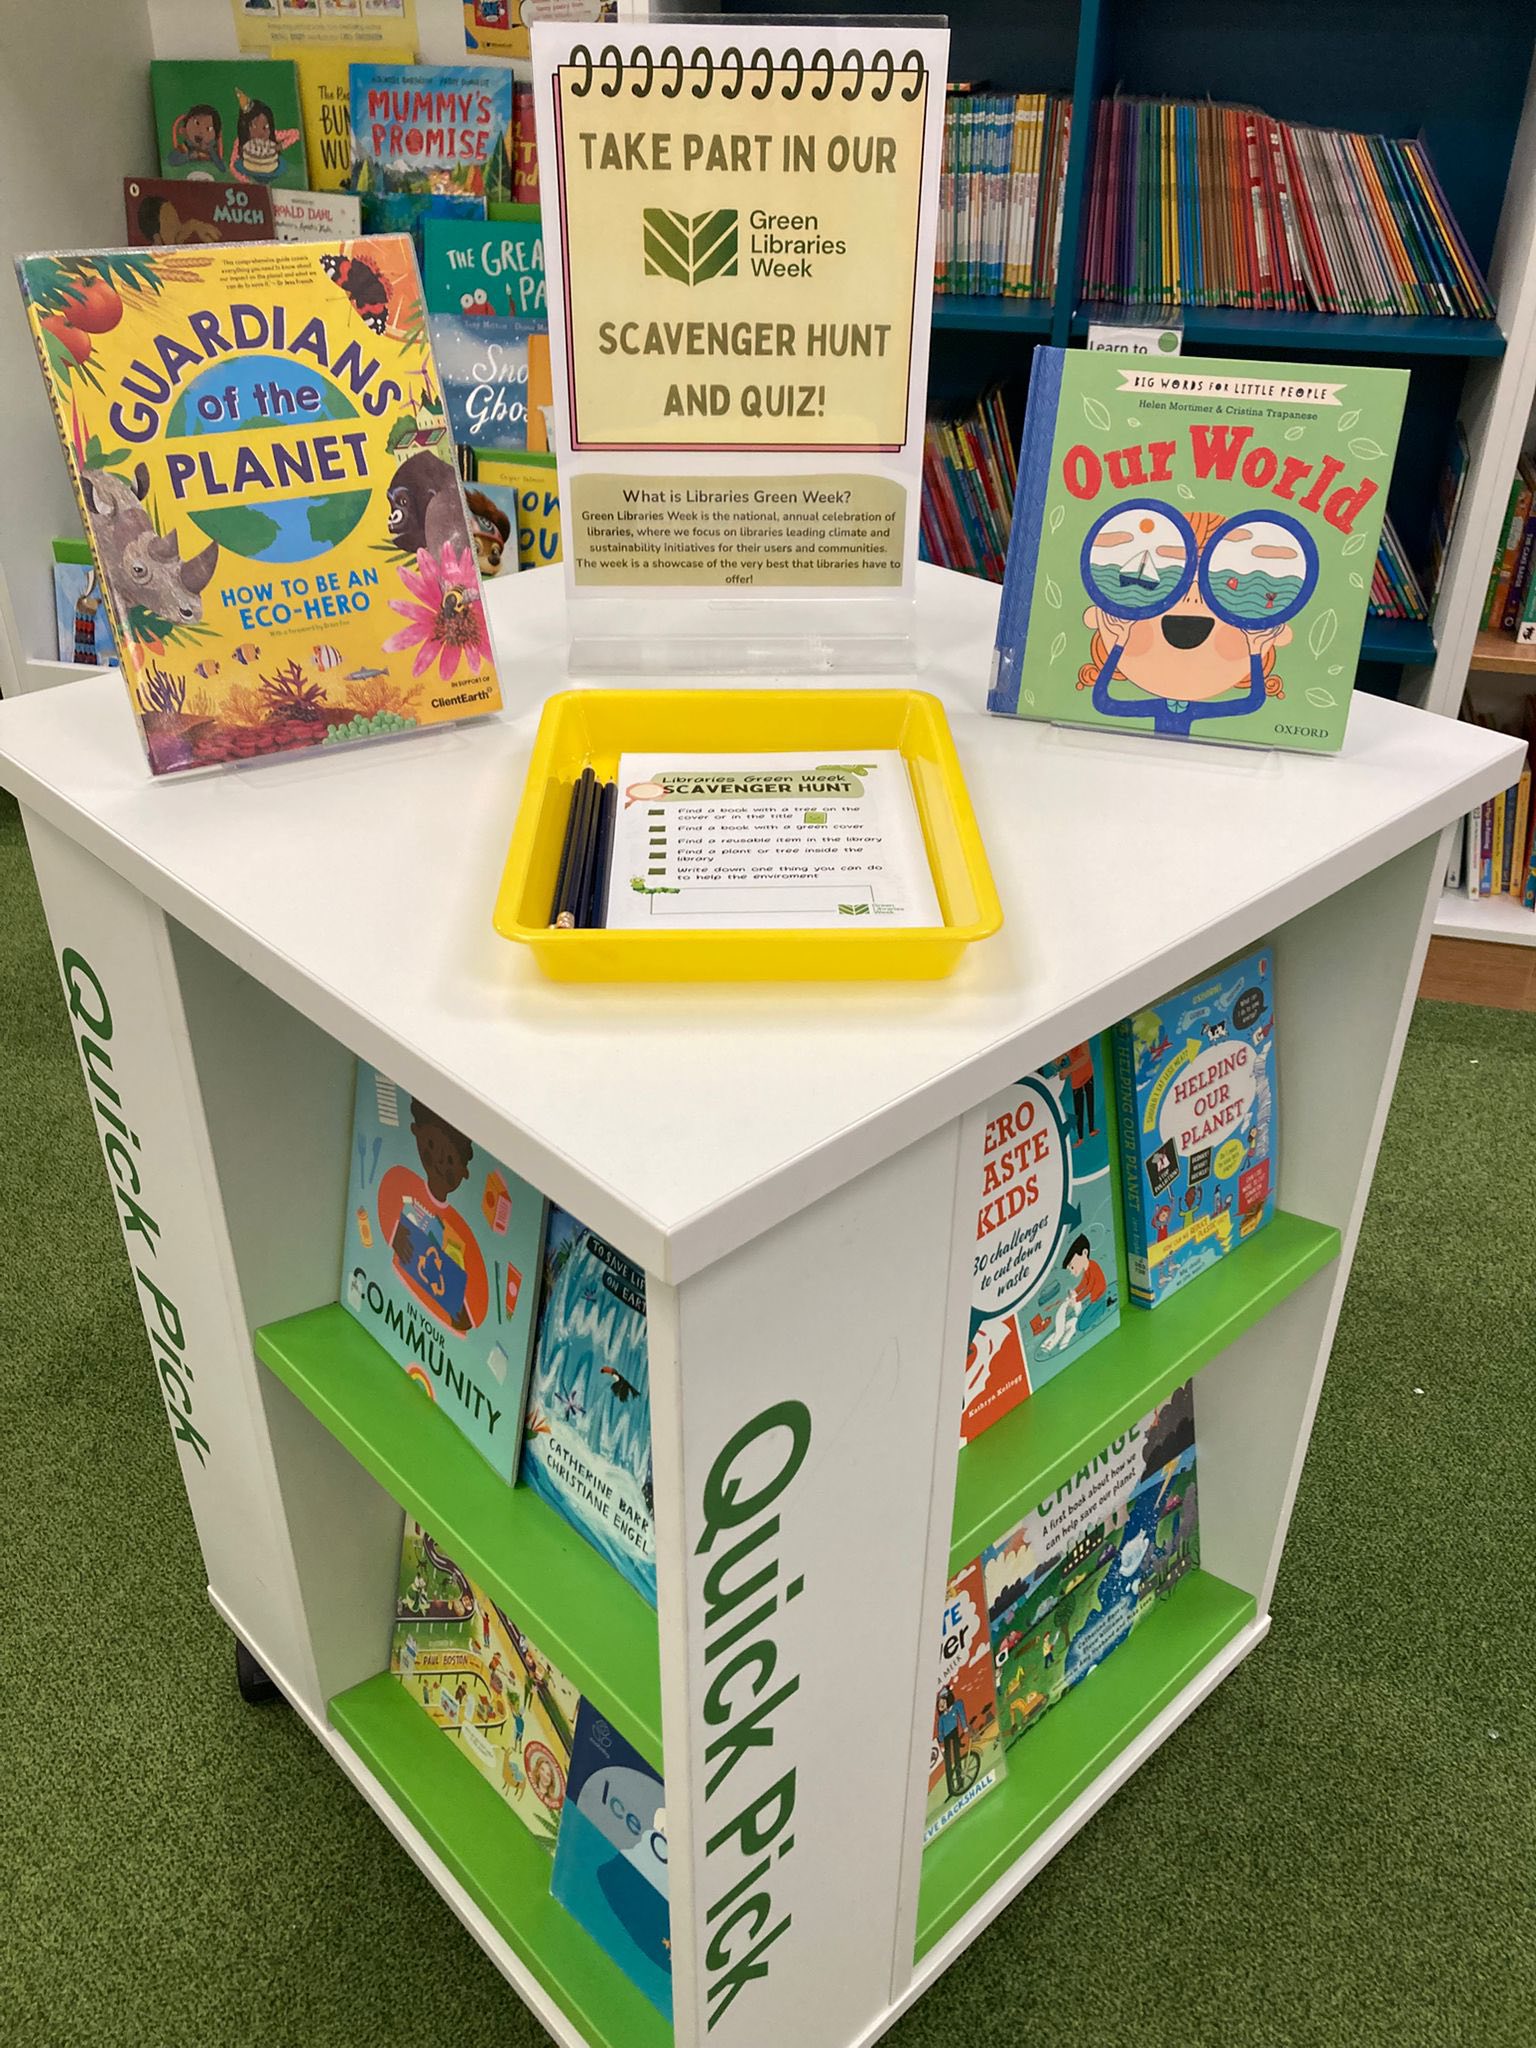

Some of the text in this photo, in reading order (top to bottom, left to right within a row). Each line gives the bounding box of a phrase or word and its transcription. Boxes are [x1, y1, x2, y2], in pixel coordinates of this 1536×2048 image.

[368, 89, 492, 124] MUMMY'S
[371, 123, 490, 160] PROMISE
[579, 132, 897, 173] TAKE PART IN OUR
[213, 205, 265, 224] MUCH
[225, 188, 248, 207] SO
[272, 204, 333, 221] ROALD DAHL
[749, 209, 819, 231] Green
[446, 238, 544, 276] THE GREA
[751, 234, 847, 255] Libraries
[750, 257, 813, 278] Week
[599, 322, 892, 357] SCAVENGER HUNT
[1133, 343, 1148, 354] to
[109, 302, 402, 444] GUARDIANS
[1134, 376, 1328, 400] BIG WORDS FOR LITTLE PEOPLE
[197, 380, 321, 421] of the
[663, 384, 826, 418] AND QUIZ!
[1138, 399, 1318, 421] Helen Mortimer & Cristina Trapanese
[165, 432, 370, 499] PLANET
[1062, 424, 1380, 536] Our World
[623, 489, 851, 503] What is Libraries Green Week?
[581, 511, 896, 522] Green Libraries Week is the national, annual celebration of
[587, 527, 890, 539] libraries, where we focus on libraries leading climate and
[576, 558, 901, 570] The week is a showcase of the very best that libraries have to
[590, 543, 888, 554] sustainability initiatives for their users and communities.
[220, 567, 379, 607] HOW TO BE AN
[725, 574, 753, 584] offer!
[239, 591, 371, 631] ECO-HERO
[431, 691, 489, 708] ClientEarth
[1273, 723, 1329, 740] OXFORD
[662, 774, 846, 784] Libraries Green Week
[662, 782, 852, 794] SCAVENGER HUNT
[1173, 1046, 1248, 1105] HELPING
[1193, 1083, 1230, 1117] OUR
[1181, 1098, 1245, 1151] PLANET
[982, 1128, 1050, 1197] ASTE
[61, 947, 211, 1470] Quick Pick
[976, 1174, 1039, 1241] KIDS
[989, 1214, 1049, 1263] challenges
[592, 1240, 628, 1277] TO SAVE
[980, 1240, 1042, 1291] to cut down
[606, 1276, 620, 1292] ON
[997, 1266, 1030, 1297] waste
[406, 1302, 445, 1349] IN YOUR
[549, 1437, 649, 1533] CATHERINE BARR
[1042, 1453, 1136, 1537] A first book about how we
[546, 1454, 649, 1556] CHRISTIANE ENGEL
[423, 1652, 468, 1666] PAUL BOSTON
[694, 1399, 812, 2034] Quick Pick
[602, 1779, 641, 1836] Ice
[941, 1775, 993, 1825] BACKSHALL
